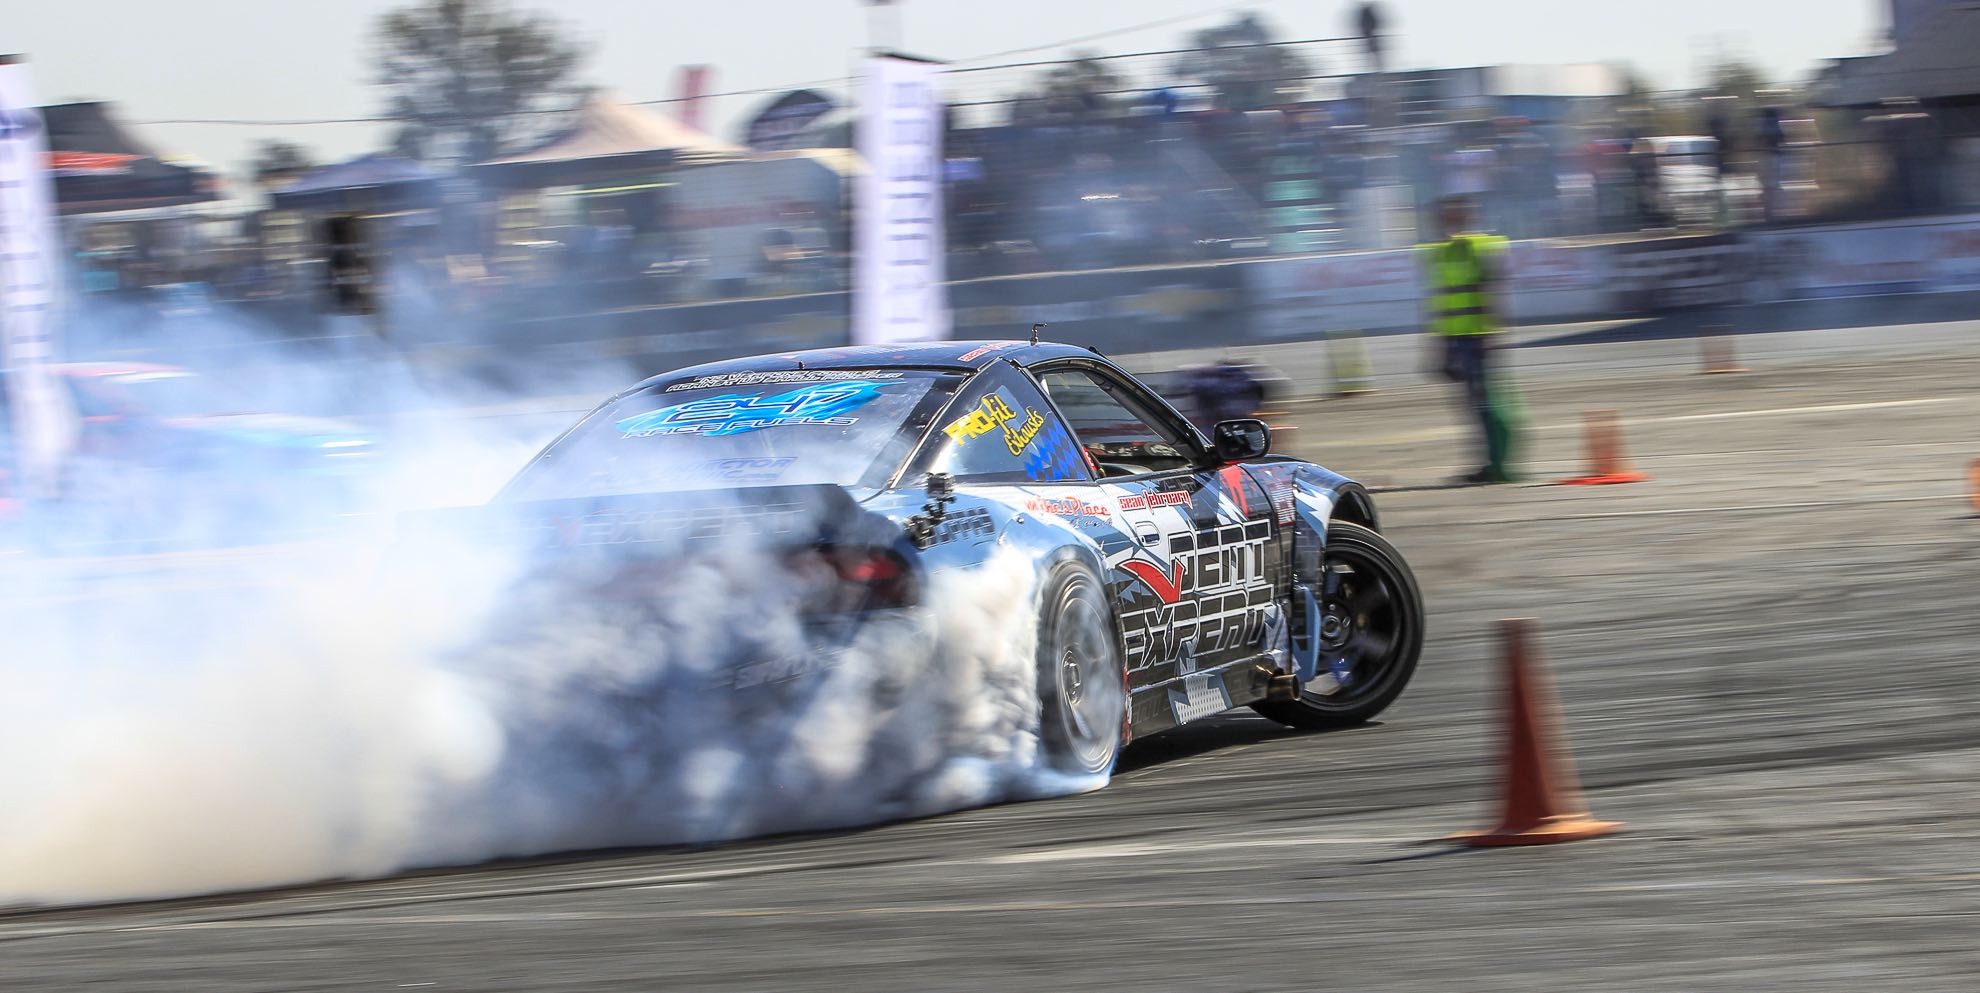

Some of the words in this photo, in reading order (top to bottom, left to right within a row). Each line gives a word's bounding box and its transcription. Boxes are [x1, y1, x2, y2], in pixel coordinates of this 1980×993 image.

[665, 388, 862, 425] 247
[622, 422, 725, 439] RACE
[725, 416, 860, 431] FUELS
[1067, 496, 1111, 516] Place
[1119, 495, 1145, 510] sean
[1168, 519, 1272, 595] DENT
[1120, 583, 1275, 674] EXPERT
